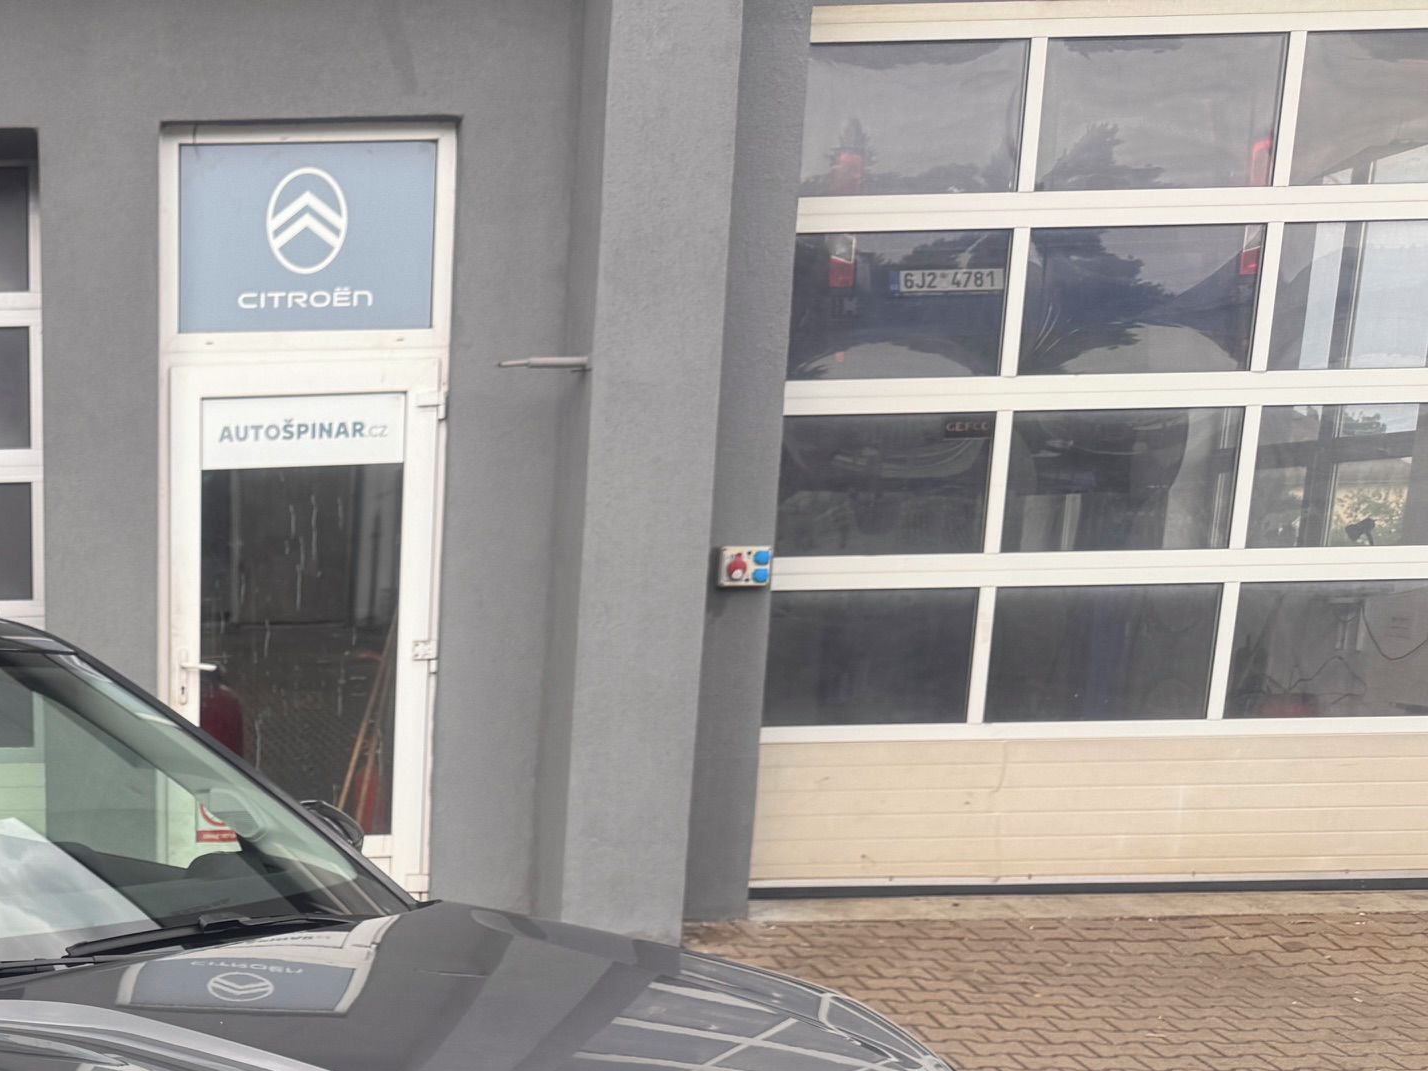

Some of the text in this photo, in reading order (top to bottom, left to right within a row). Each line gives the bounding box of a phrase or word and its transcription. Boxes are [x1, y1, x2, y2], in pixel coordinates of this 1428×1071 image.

[903, 270, 996, 290] 6J2 4781
[237, 286, 374, 310] CITROËN
